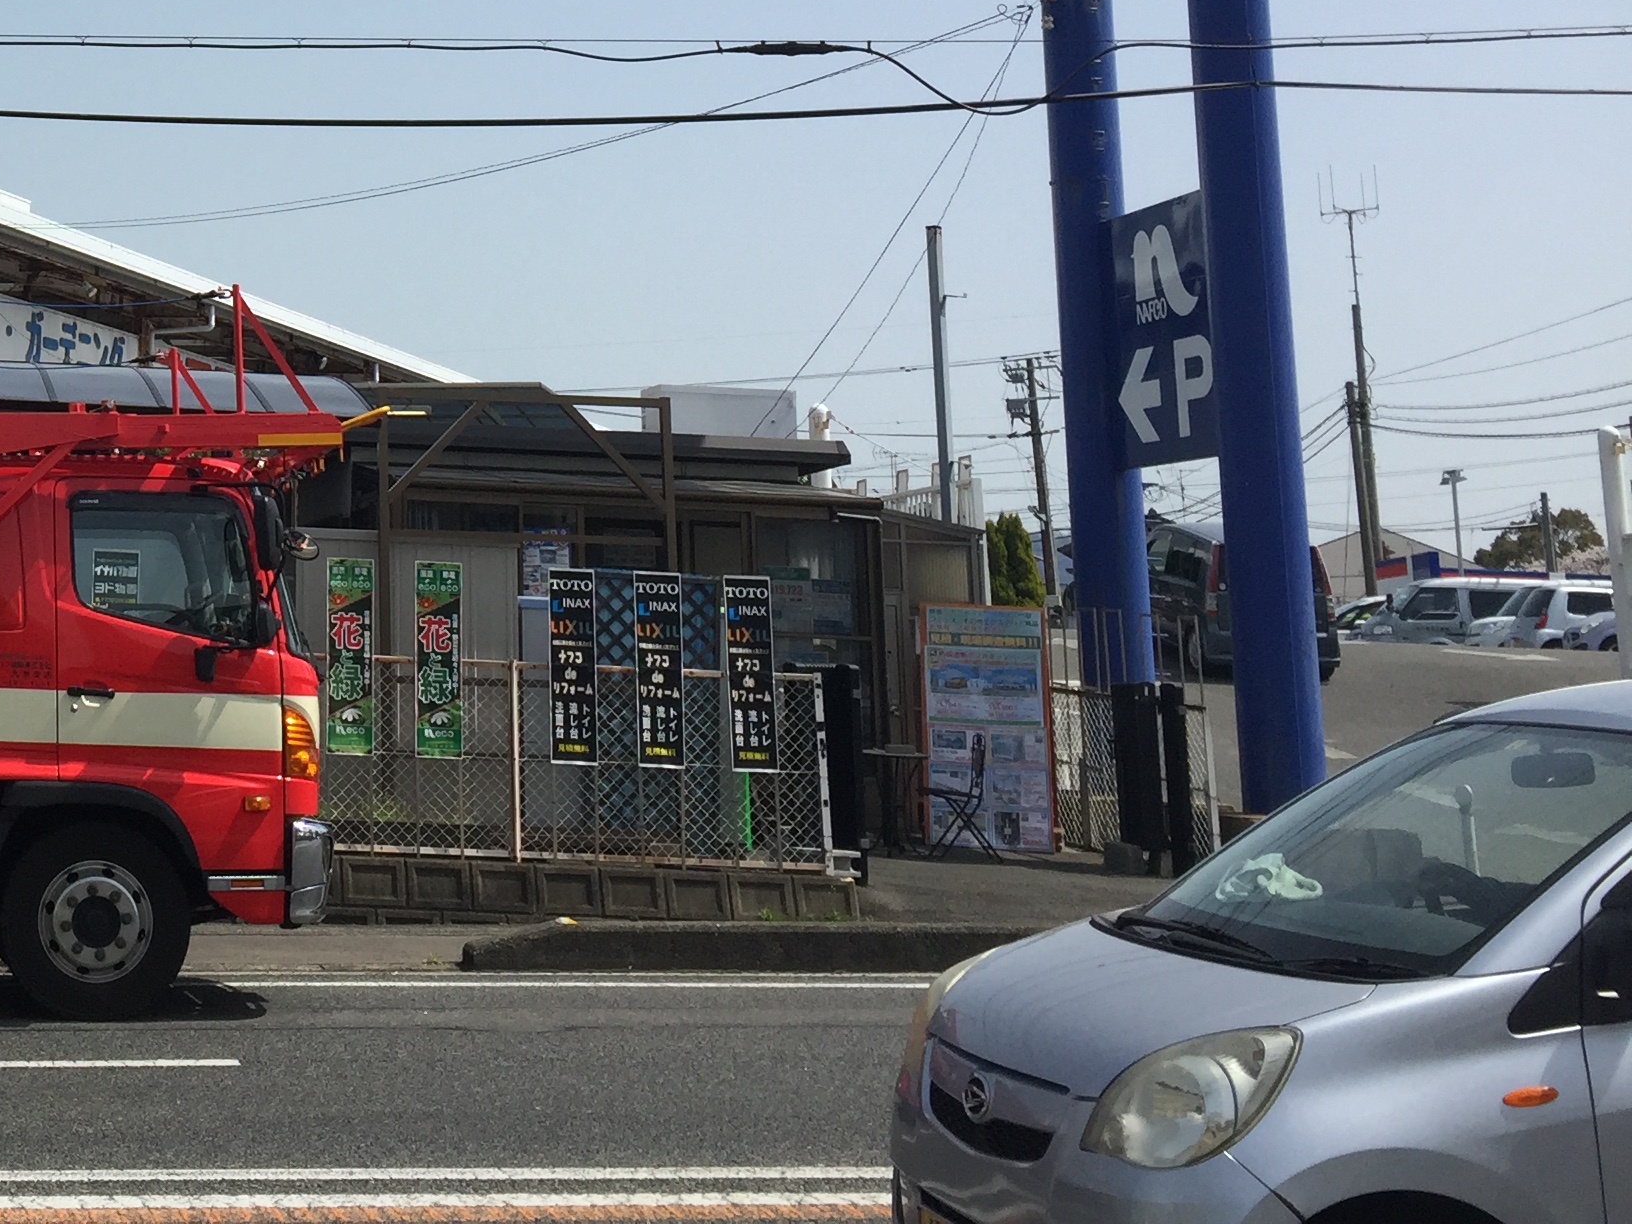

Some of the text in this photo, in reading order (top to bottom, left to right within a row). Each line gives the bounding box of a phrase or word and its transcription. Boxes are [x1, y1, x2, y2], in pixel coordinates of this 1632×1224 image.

[1136, 297, 1167, 325] NAFCO
[1173, 334, 1214, 438] P
[550, 579, 593, 592] TOTO
[635, 582, 679, 595] TOTO
[725, 586, 768, 599] TOTO
[562, 597, 591, 609] INAX
[649, 601, 678, 613] INAX
[738, 605, 767, 617] INAX
[551, 619, 593, 635] LIXIL
[637, 623, 680, 639] LIXIL
[727, 627, 770, 642] LIXIL
[330, 612, 364, 700] 花と緑
[418, 616, 452, 704] 花と緑
[558, 649, 583, 664] ナフコ
[645, 653, 670, 668] ナフコ
[735, 657, 760, 671] ナフコ
[564, 667, 578, 680] de
[651, 671, 665, 684] de
[553, 681, 593, 696] リフォーム
[742, 675, 755, 688] de
[640, 685, 680, 699] リフォーム
[731, 689, 771, 703] リフォーム
[554, 701, 565, 739] 洗面台
[568, 702, 579, 739] 流し台
[582, 704, 592, 739] トイレ
[642, 704, 652, 743] 洗面台
[656, 705, 666, 743] 流し台
[669, 707, 679, 742] トイレ
[734, 709, 744, 746] 洗面台
[748, 710, 758, 747] 流し台
[761, 710, 771, 746] トイレ
